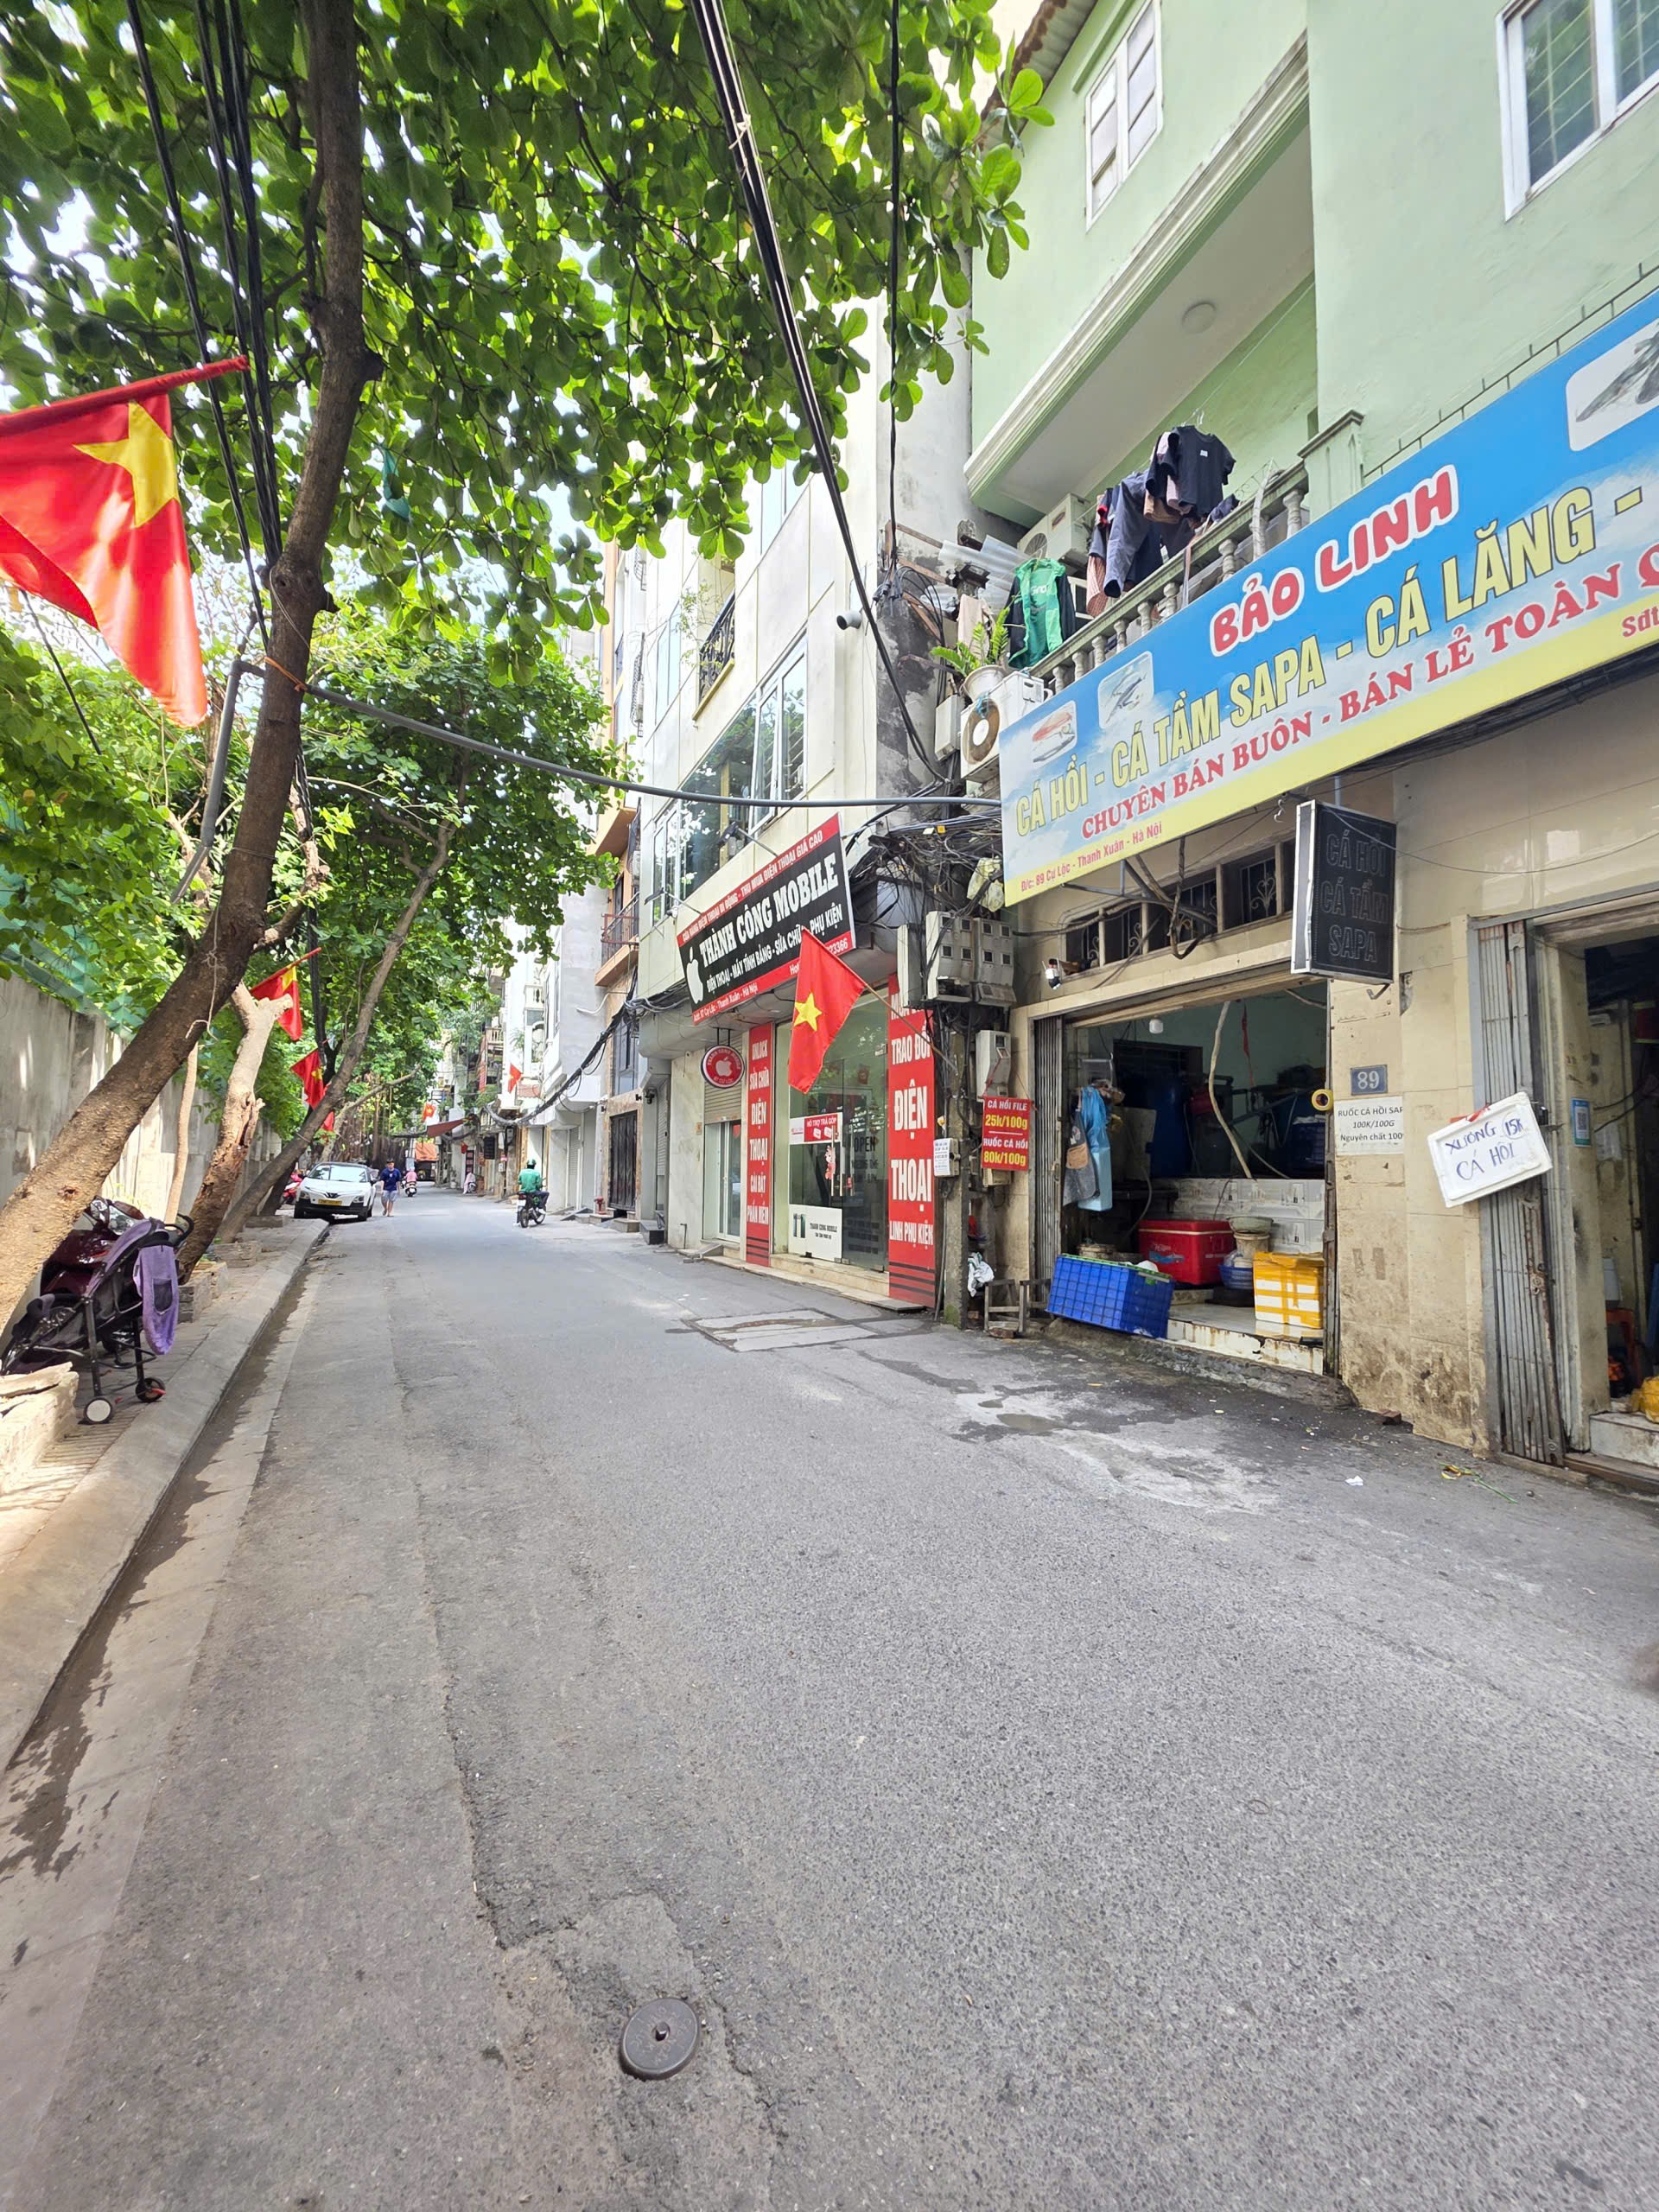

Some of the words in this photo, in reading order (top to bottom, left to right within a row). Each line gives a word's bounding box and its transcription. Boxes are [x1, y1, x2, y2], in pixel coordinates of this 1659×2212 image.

[1211, 570, 1301, 654] BẢO
[1318, 467, 1455, 589] LINH
[1016, 779, 1046, 837] CÁ
[1049, 753, 1089, 821] HỒI
[1111, 721, 1148, 788] CÁ
[1154, 689, 1221, 766] TẦM
[1230, 634, 1326, 728] SAPA
[1365, 563, 1432, 658] CÁ
[1441, 486, 1596, 623] LĂNG
[1082, 781, 1166, 839] CHUYÊN
[1173, 753, 1224, 798] BÁN
[1232, 711, 1312, 771] BUÔN
[1339, 663, 1413, 722] BÁN
[1425, 626, 1474, 683] LẺ
[1485, 563, 1621, 652] TOÀN
[778, 852, 797, 870] THOẠI
[797, 841, 809, 860] GIÁ
[809, 830, 823, 849] CAO
[1035, 874, 1045, 886] 89
[1077, 849, 1101, 868] Thanh
[1103, 839, 1123, 857] Xuân
[1132, 830, 1144, 845] Hà
[1147, 821, 1162, 839] Nội
[1325, 830, 1351, 869] CÁ
[699, 920, 737, 967] THÀNH
[736, 896, 773, 944] CÔNG
[773, 852, 839, 922] MOBILE
[1319, 877, 1345, 916] CÁ
[810, 916, 825, 937] PHỤ
[826, 901, 843, 930] KIỆN
[1329, 925, 1377, 963] SAPA
[891, 1034, 912, 1065] TRAO
[1357, 1071, 1380, 1090] 89
[751, 1096, 767, 1130] ĐIỆN
[893, 1079, 928, 1140] ĐIỆN
[985, 1114, 1028, 1130] 25k/100g
[987, 1098, 998, 1109] CÁ
[1012, 1102, 1027, 1111] FILE
[1338, 1106, 1359, 1117] RUỐC
[1360, 1106, 1370, 1116] CÁ
[1340, 1133, 1368, 1142] Nguyên
[1352, 1119, 1395, 1129] 100K/100G
[749, 1137, 768, 1166] THOẠI
[983, 1151, 1027, 1166] 80k/100g
[1003, 1137, 1014, 1148] CÁ
[891, 1158, 932, 1212] THOẠI
[889, 1219, 904, 1242] LINH
[904, 1220, 917, 1248] PHỤ
[918, 1218, 934, 1249] KIỆN
